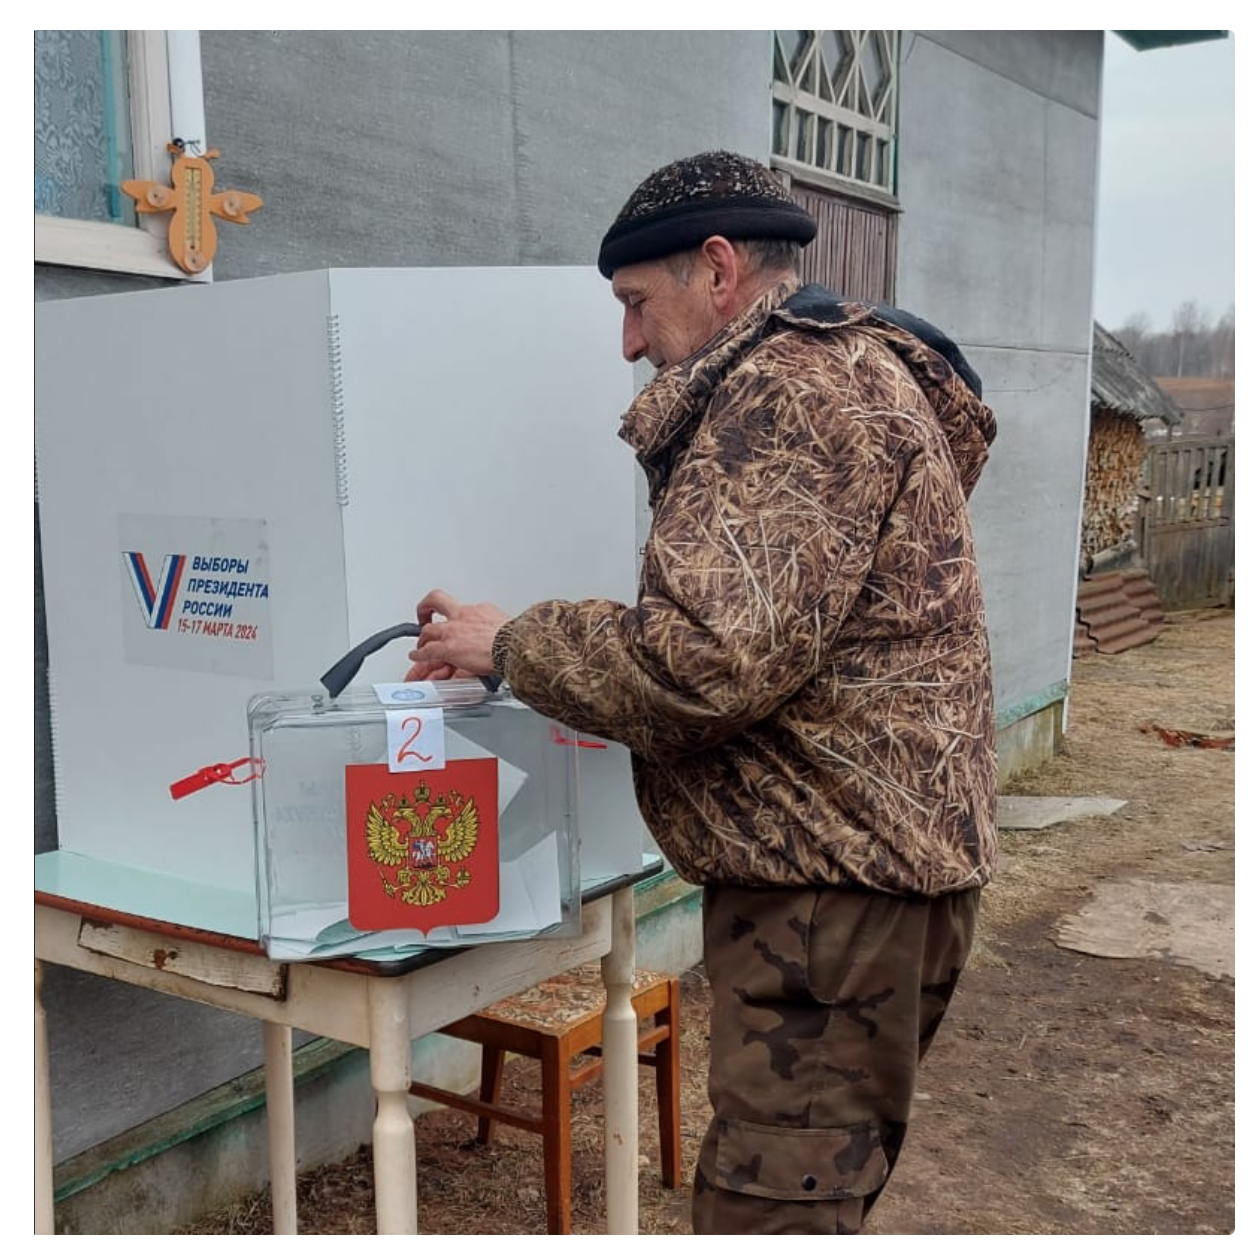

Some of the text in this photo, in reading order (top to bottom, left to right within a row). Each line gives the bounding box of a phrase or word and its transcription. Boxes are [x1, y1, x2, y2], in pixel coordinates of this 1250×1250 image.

[192, 556, 249, 574] ВЫБОРЫ
[187, 578, 269, 599] ПРЕЗИДЕНТА
[182, 600, 233, 618] РОССИИ
[177, 618, 257, 640] 15-17 МАРТА 2024
[397, 717, 433, 763] 2
